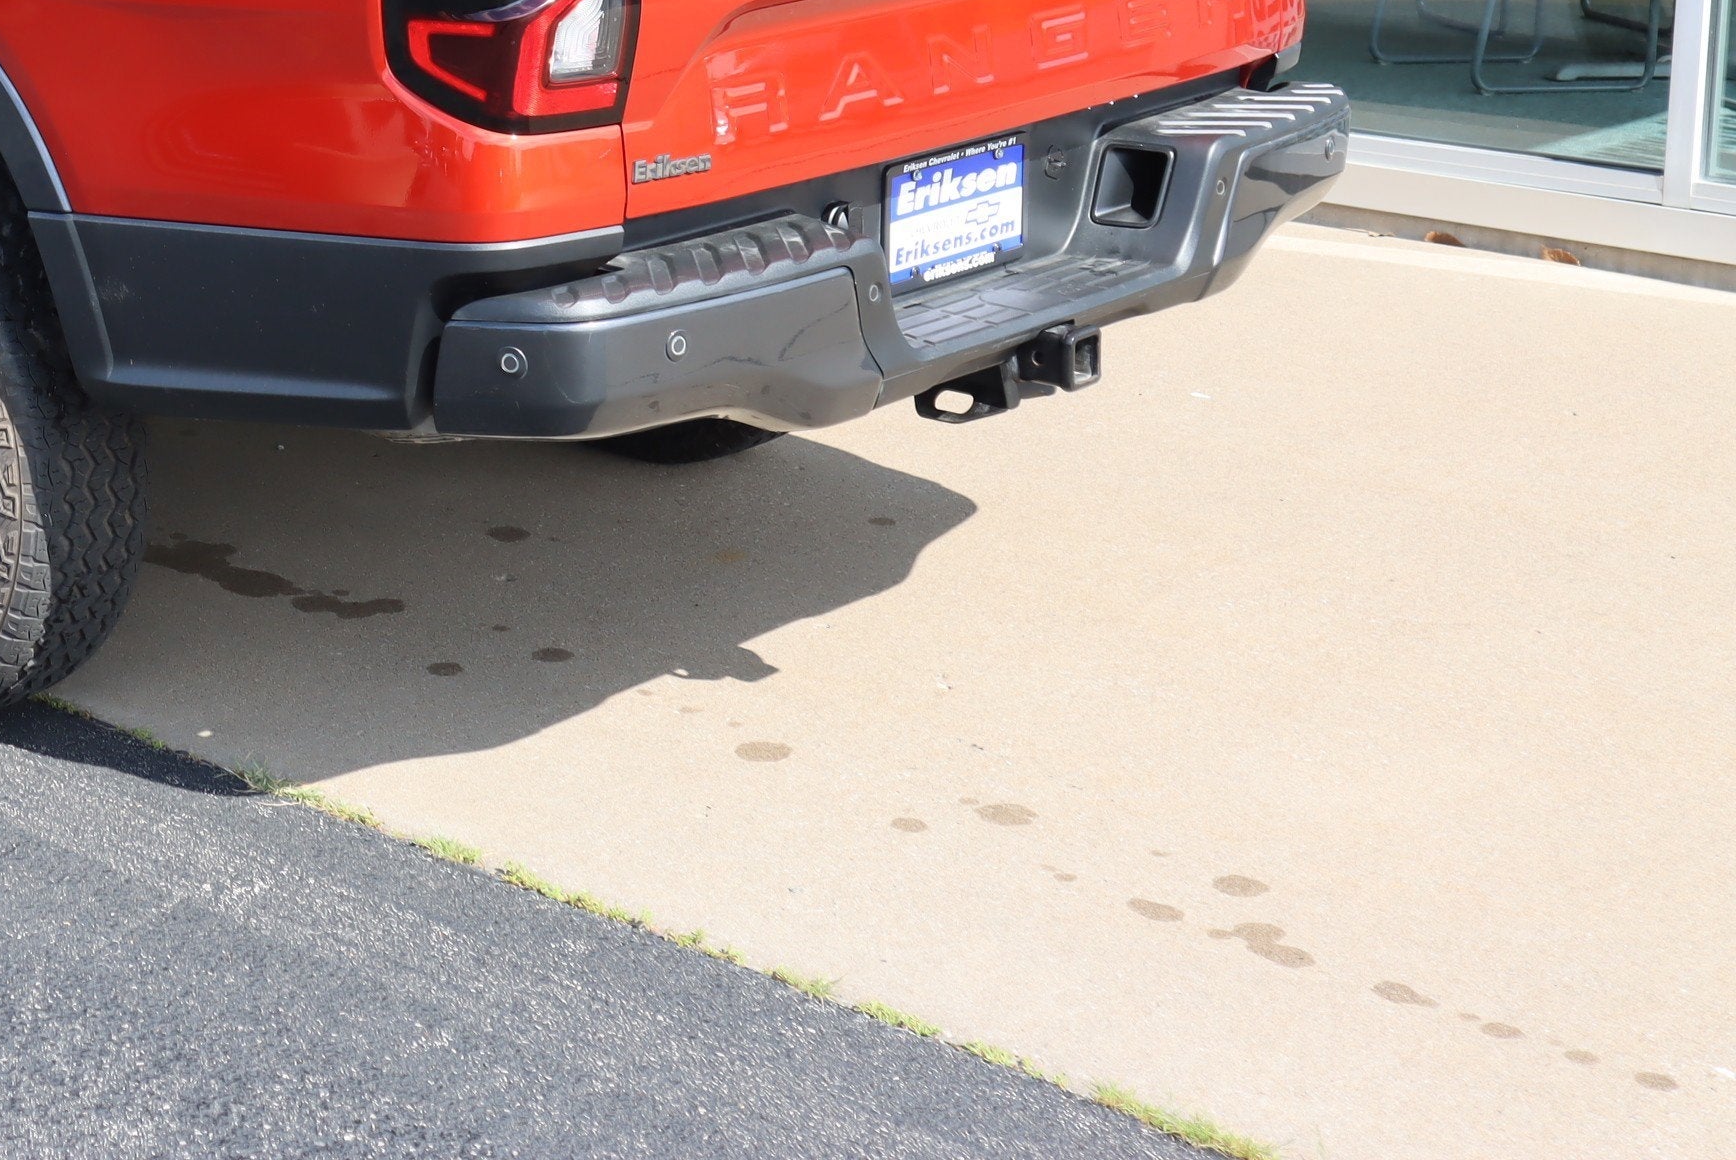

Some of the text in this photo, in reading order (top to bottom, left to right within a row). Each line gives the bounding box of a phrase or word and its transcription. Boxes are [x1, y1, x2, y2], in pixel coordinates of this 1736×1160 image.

[632, 153, 712, 184] Eriksen
[903, 160, 927, 173] Eriksen
[965, 146, 985, 157] Where
[896, 161, 1017, 216] Eriksen
[895, 220, 1015, 266] Eriksens.com
